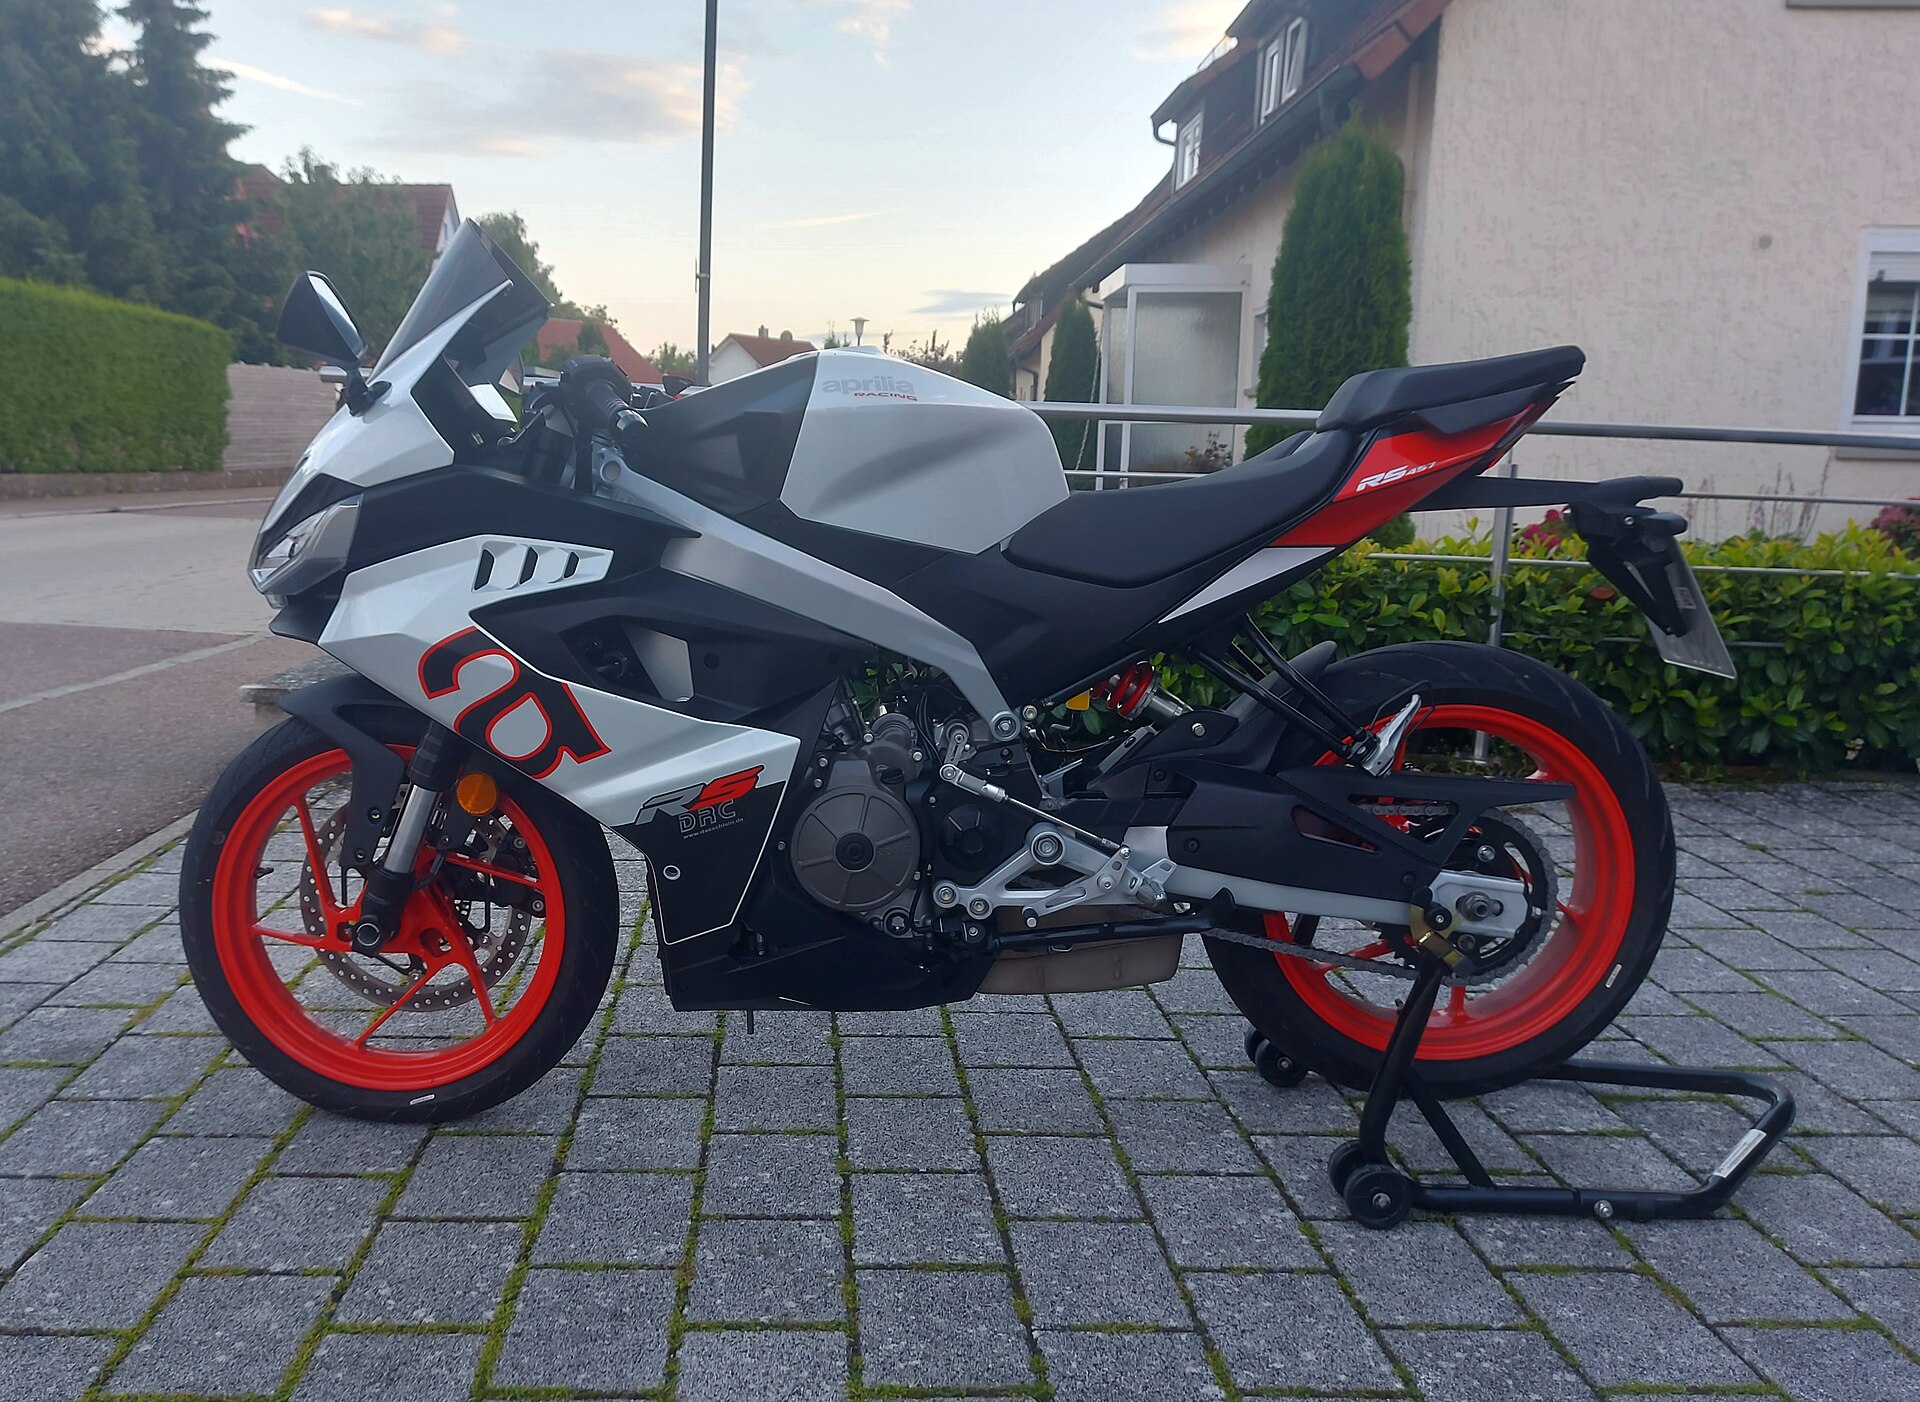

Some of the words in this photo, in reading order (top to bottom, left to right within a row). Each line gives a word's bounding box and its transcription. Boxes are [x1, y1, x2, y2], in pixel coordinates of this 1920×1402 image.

[822, 376, 915, 394] aprilia
[854, 392, 918, 402] RACING
[1356, 465, 1409, 492] RS
[634, 764, 765, 825] RS
[678, 798, 736, 833] DRC
